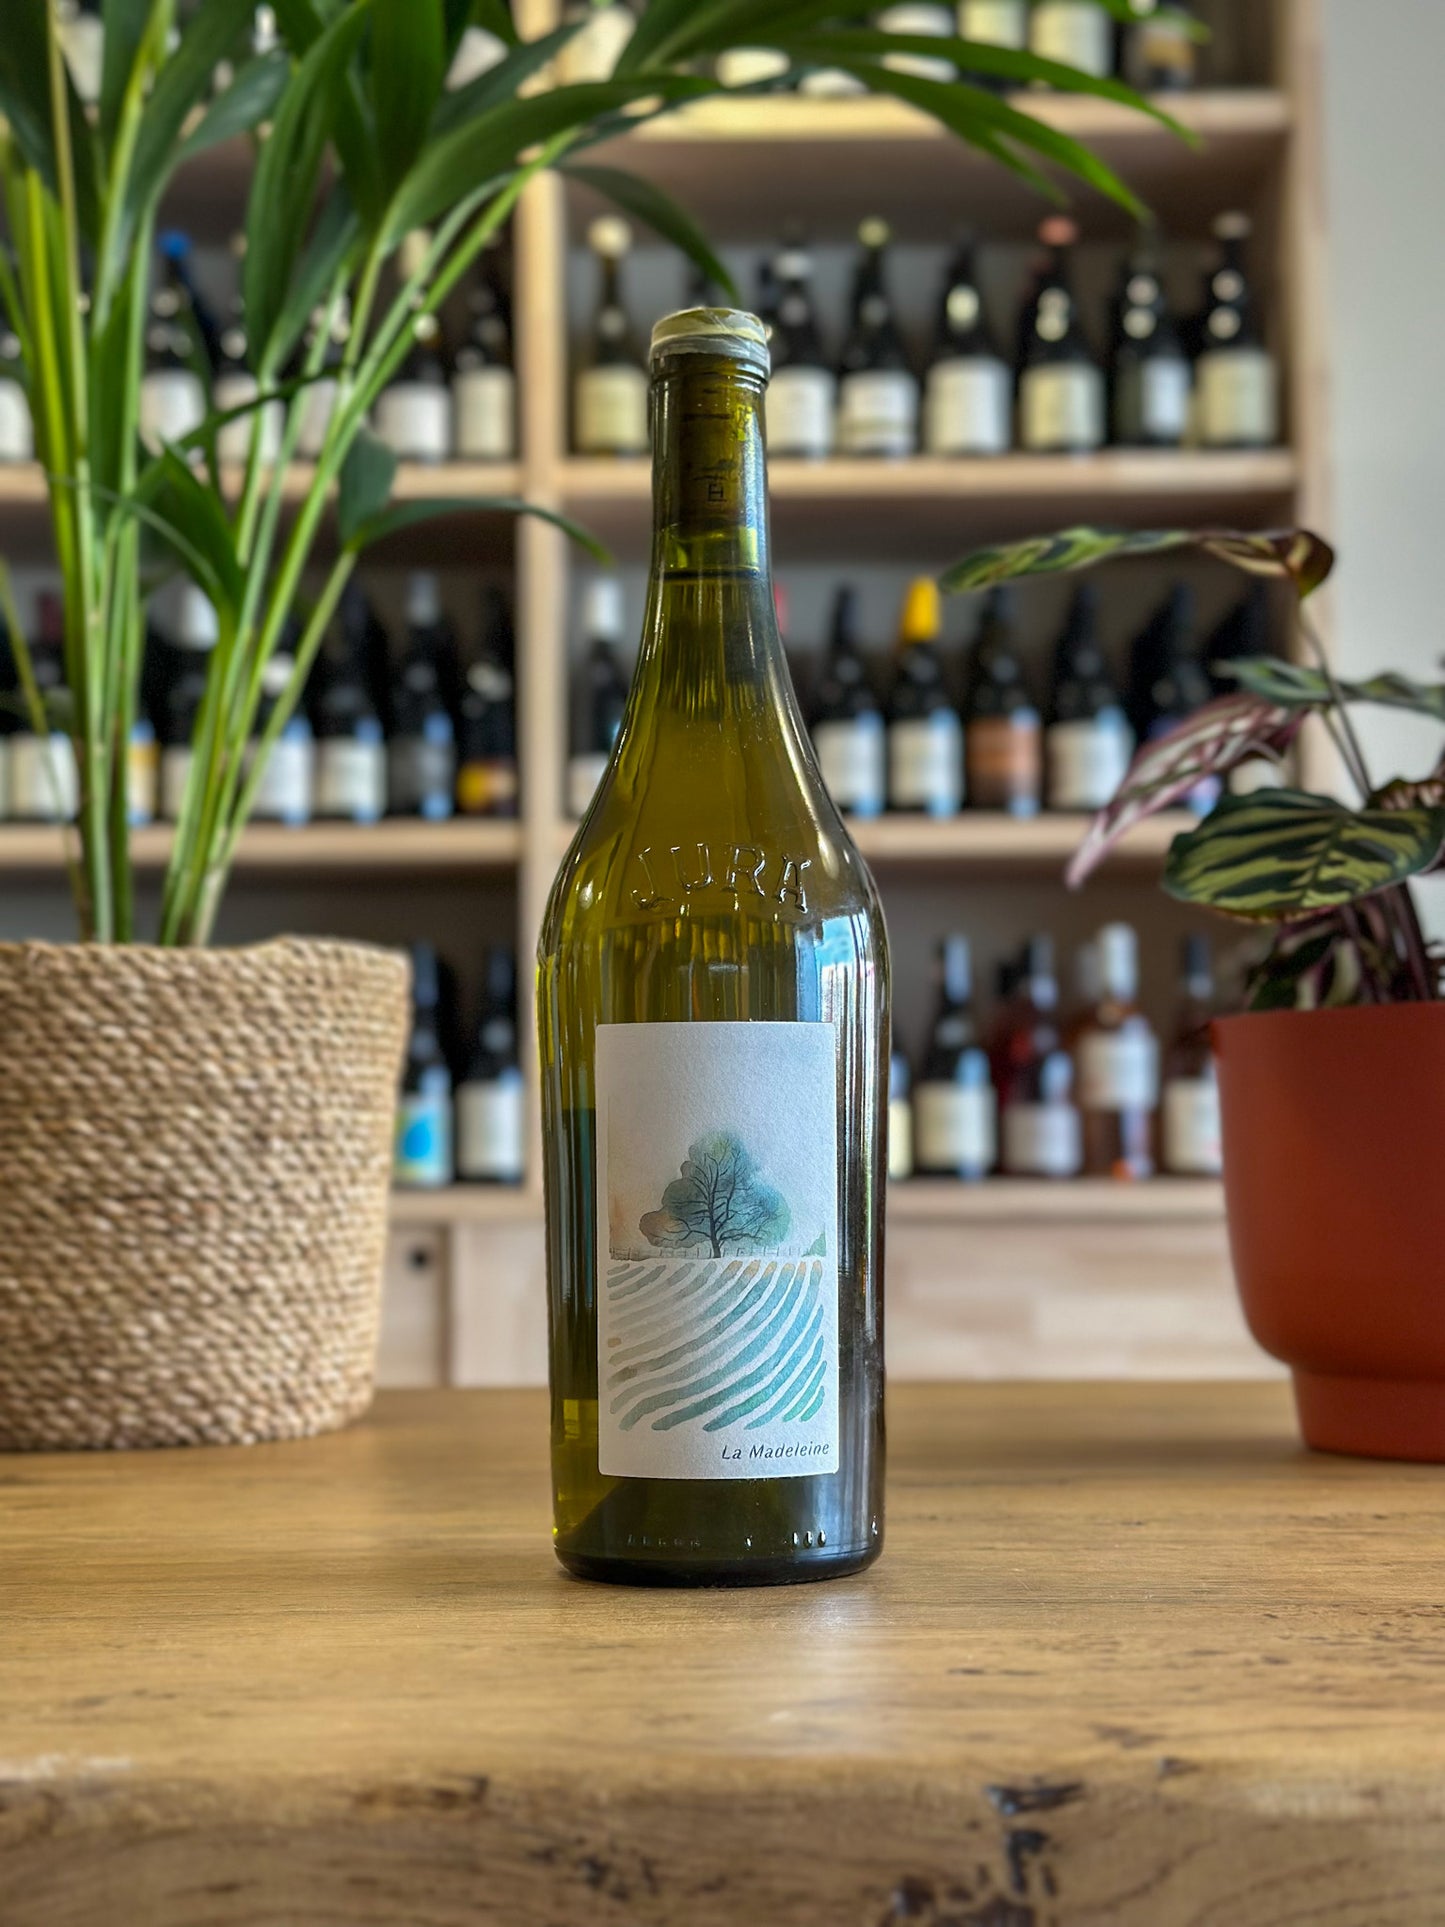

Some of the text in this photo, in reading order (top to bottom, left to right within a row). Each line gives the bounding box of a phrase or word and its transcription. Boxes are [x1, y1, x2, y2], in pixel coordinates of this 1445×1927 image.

[630, 842, 813, 914] JURA
[721, 1440, 831, 1460] La Madeleine
